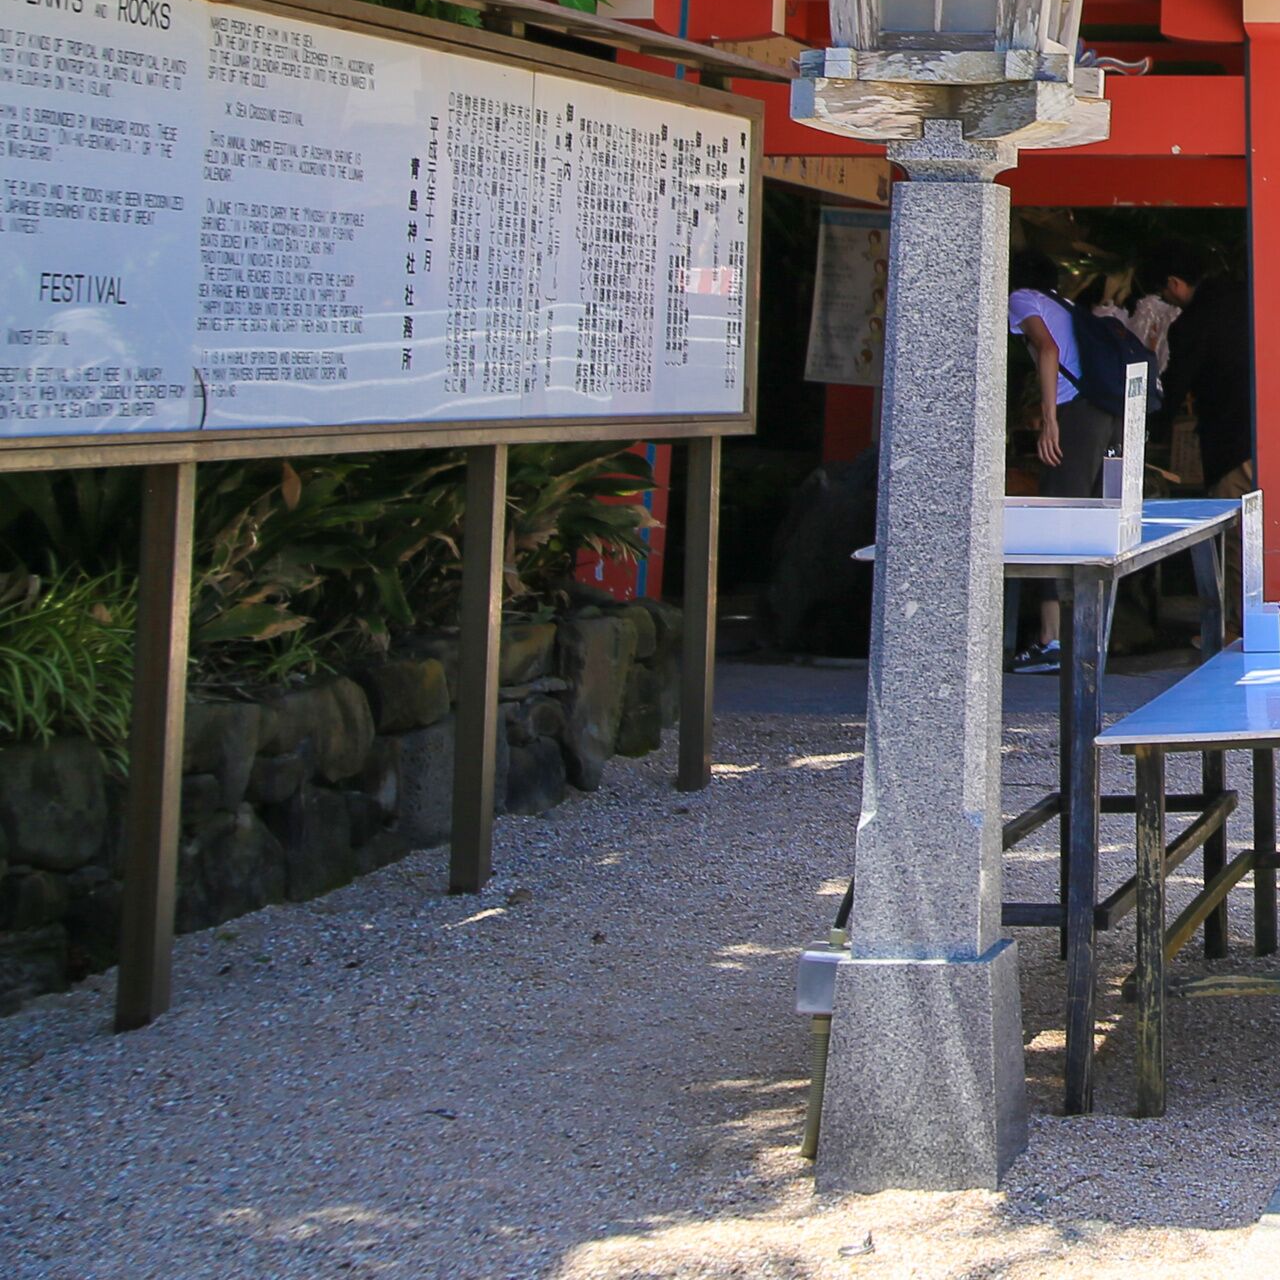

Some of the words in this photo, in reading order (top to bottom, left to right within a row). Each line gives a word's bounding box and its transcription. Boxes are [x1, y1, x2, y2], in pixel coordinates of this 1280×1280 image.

[230, 21, 251, 36] PEOPLE
[261, 44, 271, 57] THE
[162, 59, 188, 75] PLANTS
[327, 72, 337, 84] THE
[39, 272, 127, 304] FESTIVAL
